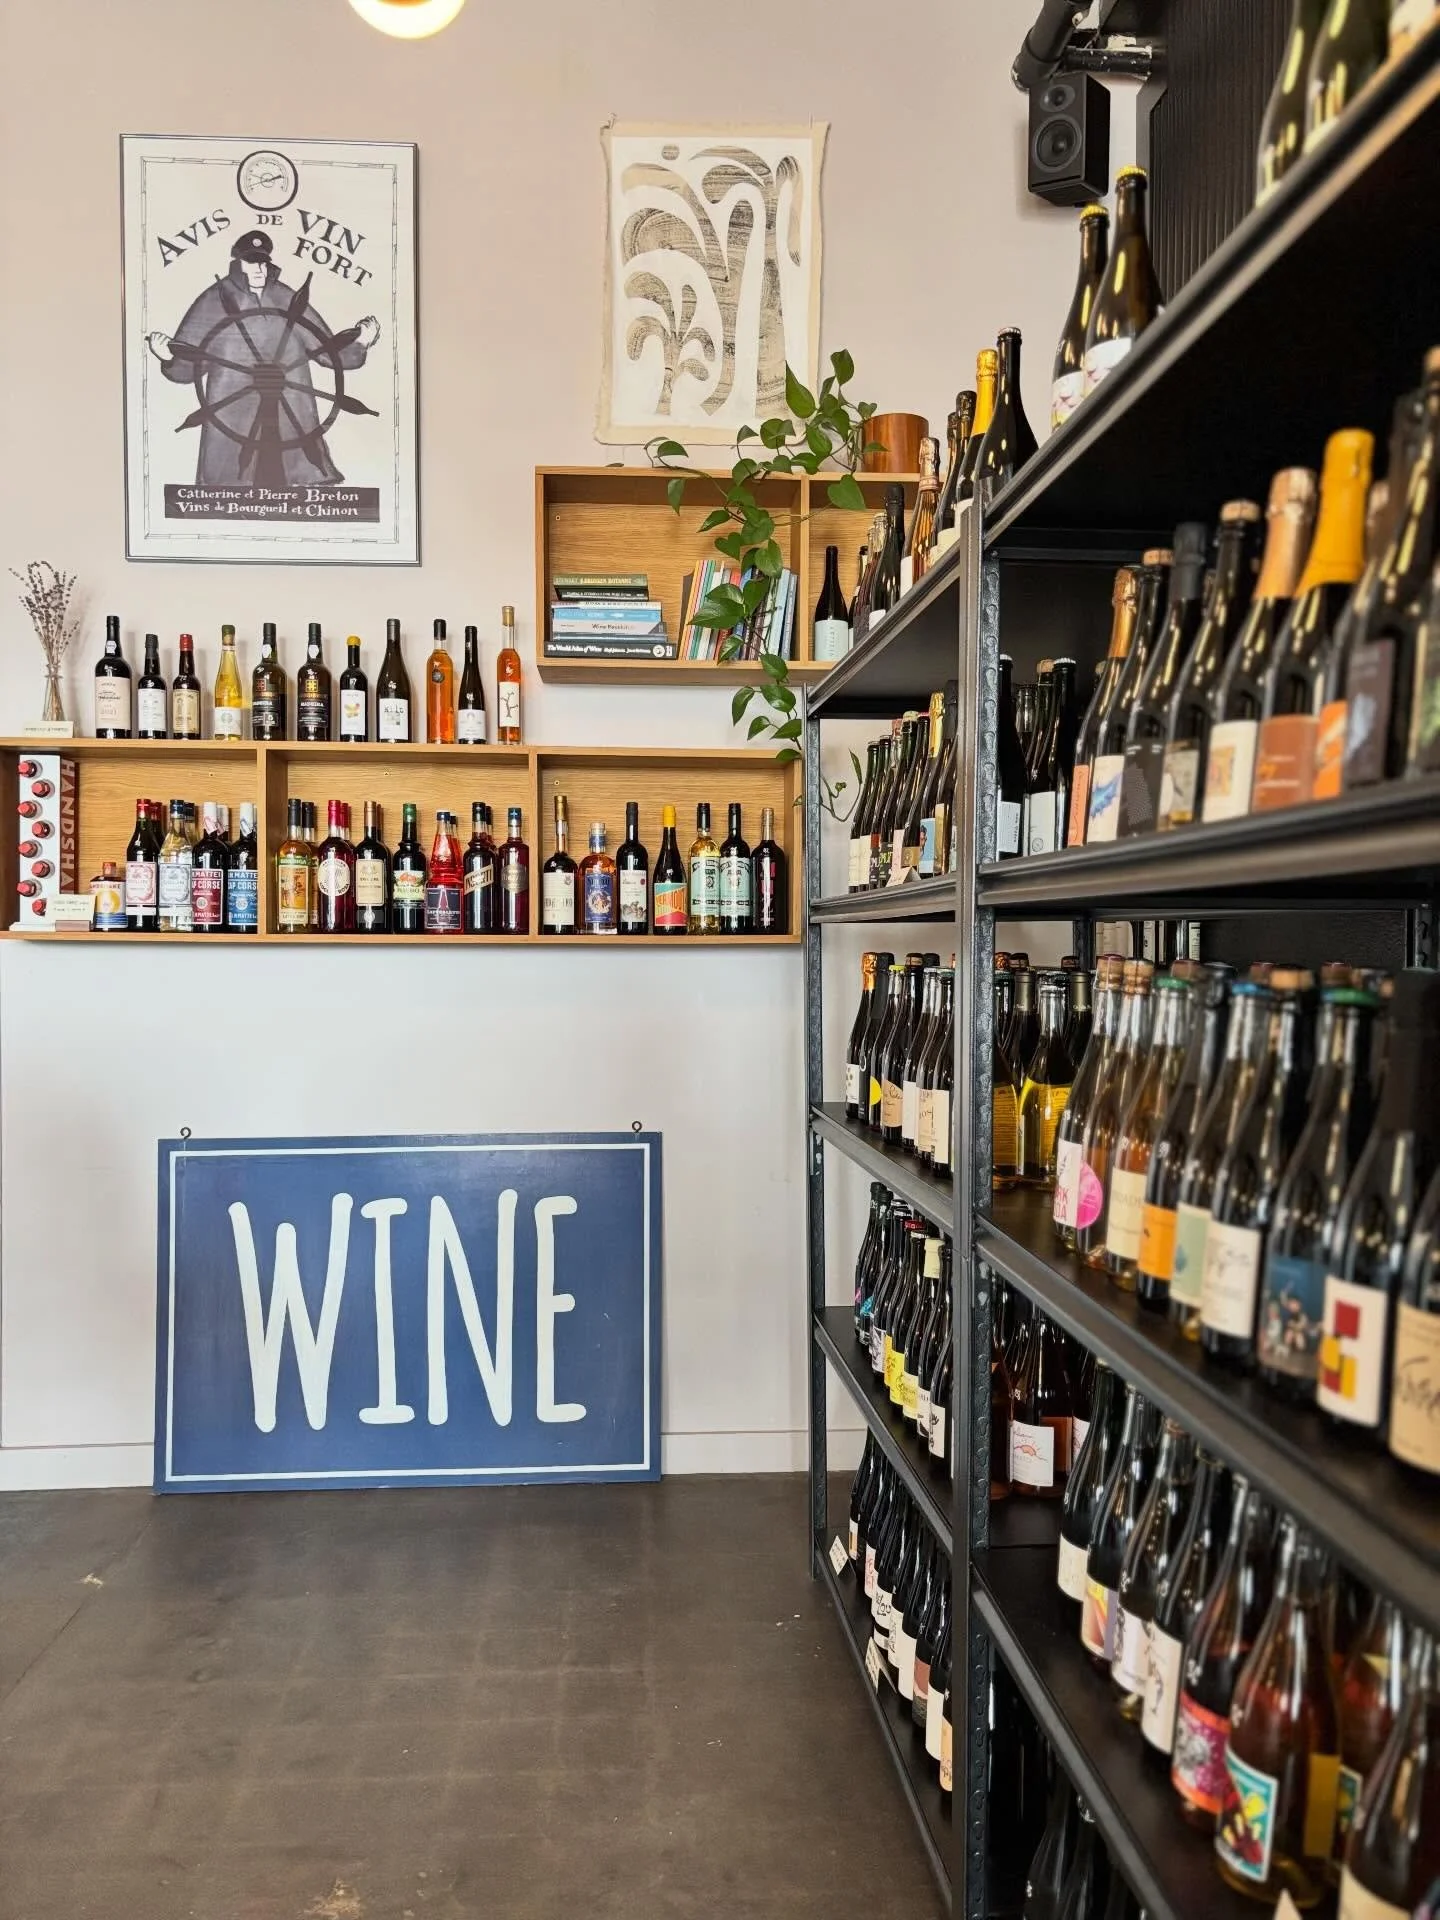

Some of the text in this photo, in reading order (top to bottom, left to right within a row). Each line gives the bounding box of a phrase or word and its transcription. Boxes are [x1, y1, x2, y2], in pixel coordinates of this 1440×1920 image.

[157, 209, 367, 267] AVIS DE VIN
[293, 236, 372, 287] FORT
[176, 502, 358, 517] Vins de Bourgueil et Chinon
[177, 488, 360, 502] Catherine et Pierre Breton
[238, 882, 257, 890] CORS
[228, 1188, 587, 1433] WINE
